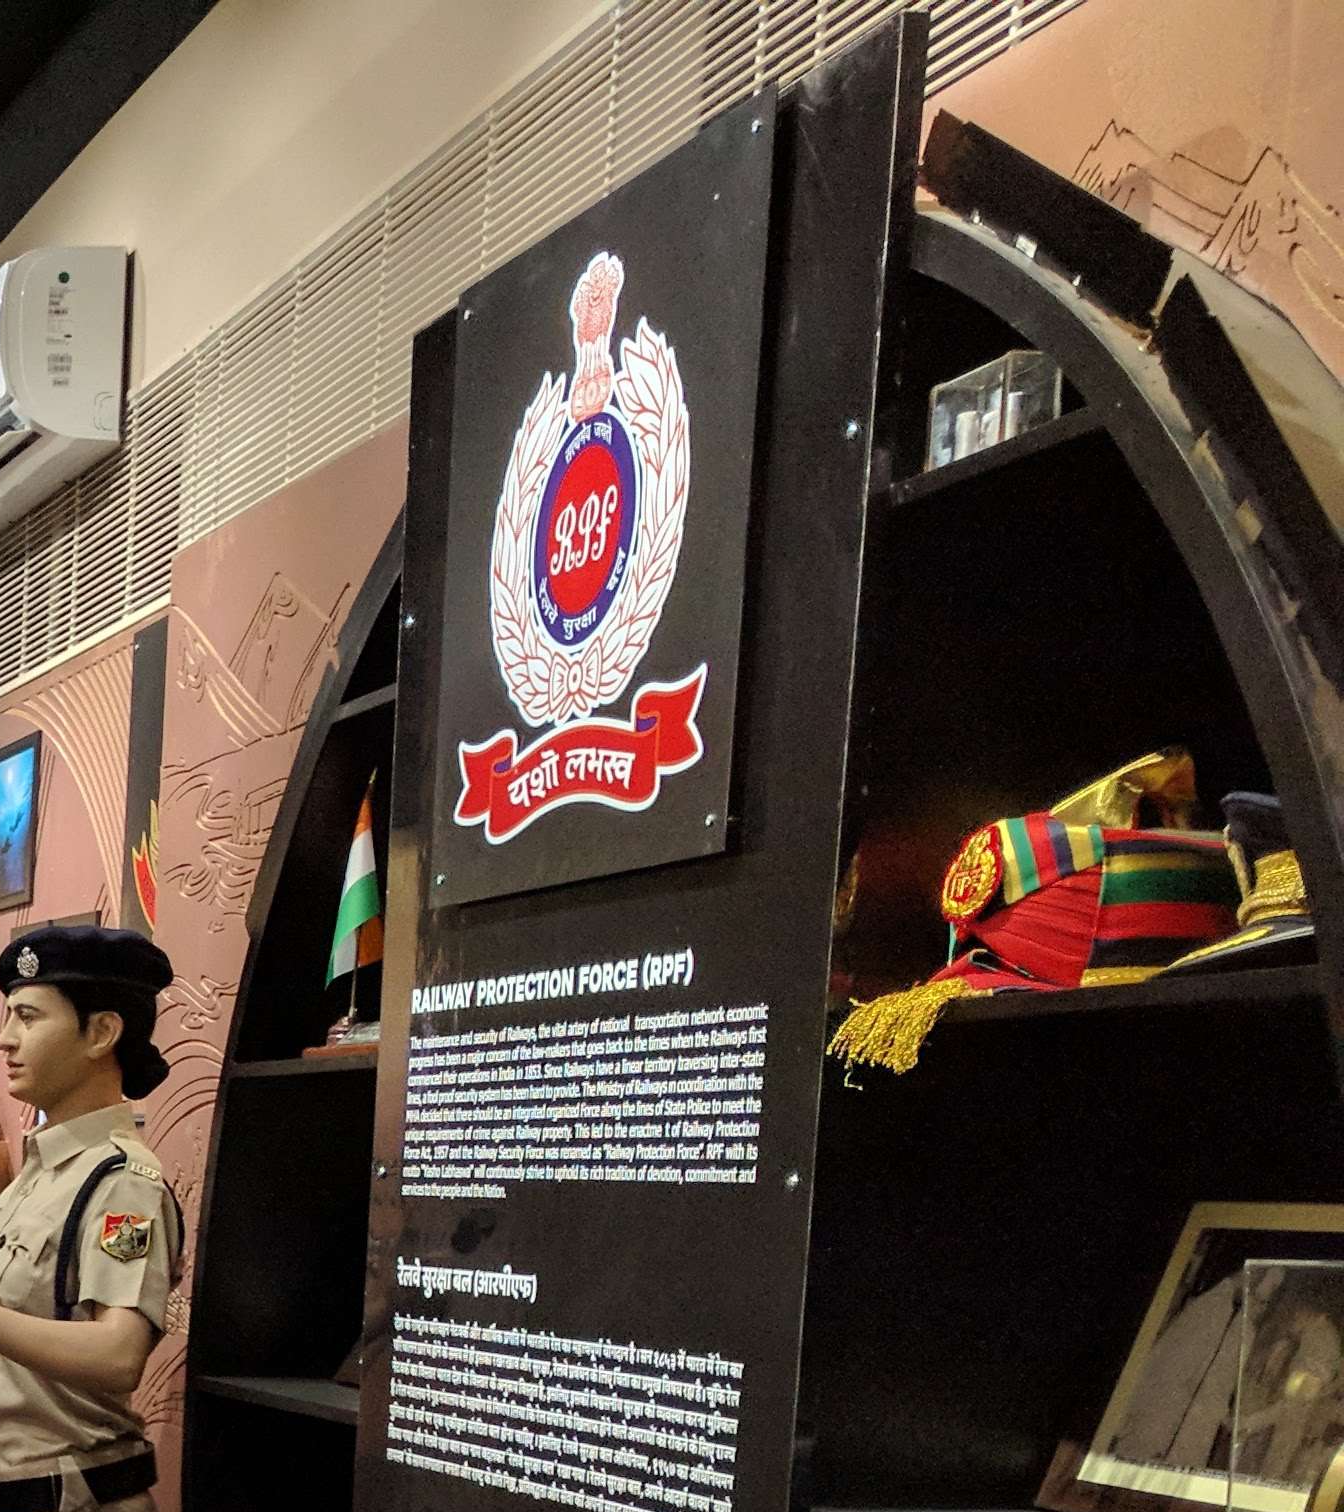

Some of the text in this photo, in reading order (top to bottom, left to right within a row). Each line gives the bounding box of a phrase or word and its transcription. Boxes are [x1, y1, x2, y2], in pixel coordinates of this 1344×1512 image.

[539, 546, 626, 640] रेलवे सुरक्षा बल
[507, 747, 636, 808] यशो लभस्व
[411, 946, 695, 1014] RAILWAY PROTECTION FORCE (RPF)
[461, 1031, 473, 1046] and
[499, 1027, 507, 1043] of
[538, 1023, 551, 1040] the
[551, 1020, 566, 1038] vital
[567, 1021, 589, 1039] artery
[589, 1017, 600, 1035] of
[599, 1014, 630, 1034] national
[634, 1009, 690, 1033] transportation
[691, 1005, 726, 1026] network
[726, 1002, 769, 1022] economic
[520, 1044, 532, 1060] the
[572, 1040, 586, 1057] that
[586, 1042, 605, 1059] goes
[605, 1037, 624, 1055] back
[625, 1036, 634, 1053] to
[634, 1034, 648, 1052] the
[648, 1033, 670, 1051] times
[671, 1031, 694, 1049] when
[694, 1029, 709, 1048] the
[710, 1027, 747, 1049] Railways
[748, 1025, 767, 1044] first
[544, 1062, 563, 1079] Since
[595, 1059, 615, 1077] have
[615, 1061, 621, 1075] a
[622, 1057, 644, 1075] linear
[644, 1055, 677, 1075] territory
[678, 1053, 718, 1073] traversing
[720, 1050, 765, 1069] inter-state
[582, 1081, 596, 1097] The
[596, 1079, 626, 1099] Ministry
[626, 1079, 635, 1097] of
[634, 1077, 668, 1098] Railways
[677, 1075, 728, 1093] coordination
[728, 1073, 747, 1091] with
[747, 1072, 764, 1090] the
[622, 1100, 636, 1118] the
[636, 1098, 654, 1117] lines
[655, 1097, 664, 1116] of
[664, 1097, 686, 1116] State
[687, 1097, 711, 1115] Police
[711, 1097, 722, 1114] to
[722, 1097, 746, 1114] meet
[746, 1095, 762, 1113] the
[574, 1122, 591, 1139] This
[591, 1121, 604, 1139] led
[604, 1121, 614, 1139] to
[614, 1120, 628, 1139] the
[671, 1119, 682, 1138] of
[682, 1118, 715, 1141] Railway
[715, 1118, 761, 1138] Protection
[593, 1147, 603, 1160] as
[636, 1142, 675, 1161] Protection
[706, 1142, 726, 1161] RPF
[725, 1142, 746, 1161] with
[746, 1142, 759, 1161] its
[637, 1164, 648, 1182] of
[647, 1165, 684, 1185] devotion,
[684, 1166, 738, 1183] commitment
[738, 1163, 758, 1184] and
[397, 1255, 538, 1304] रेलवे सुरक्षा बल (आरपीएफ)
